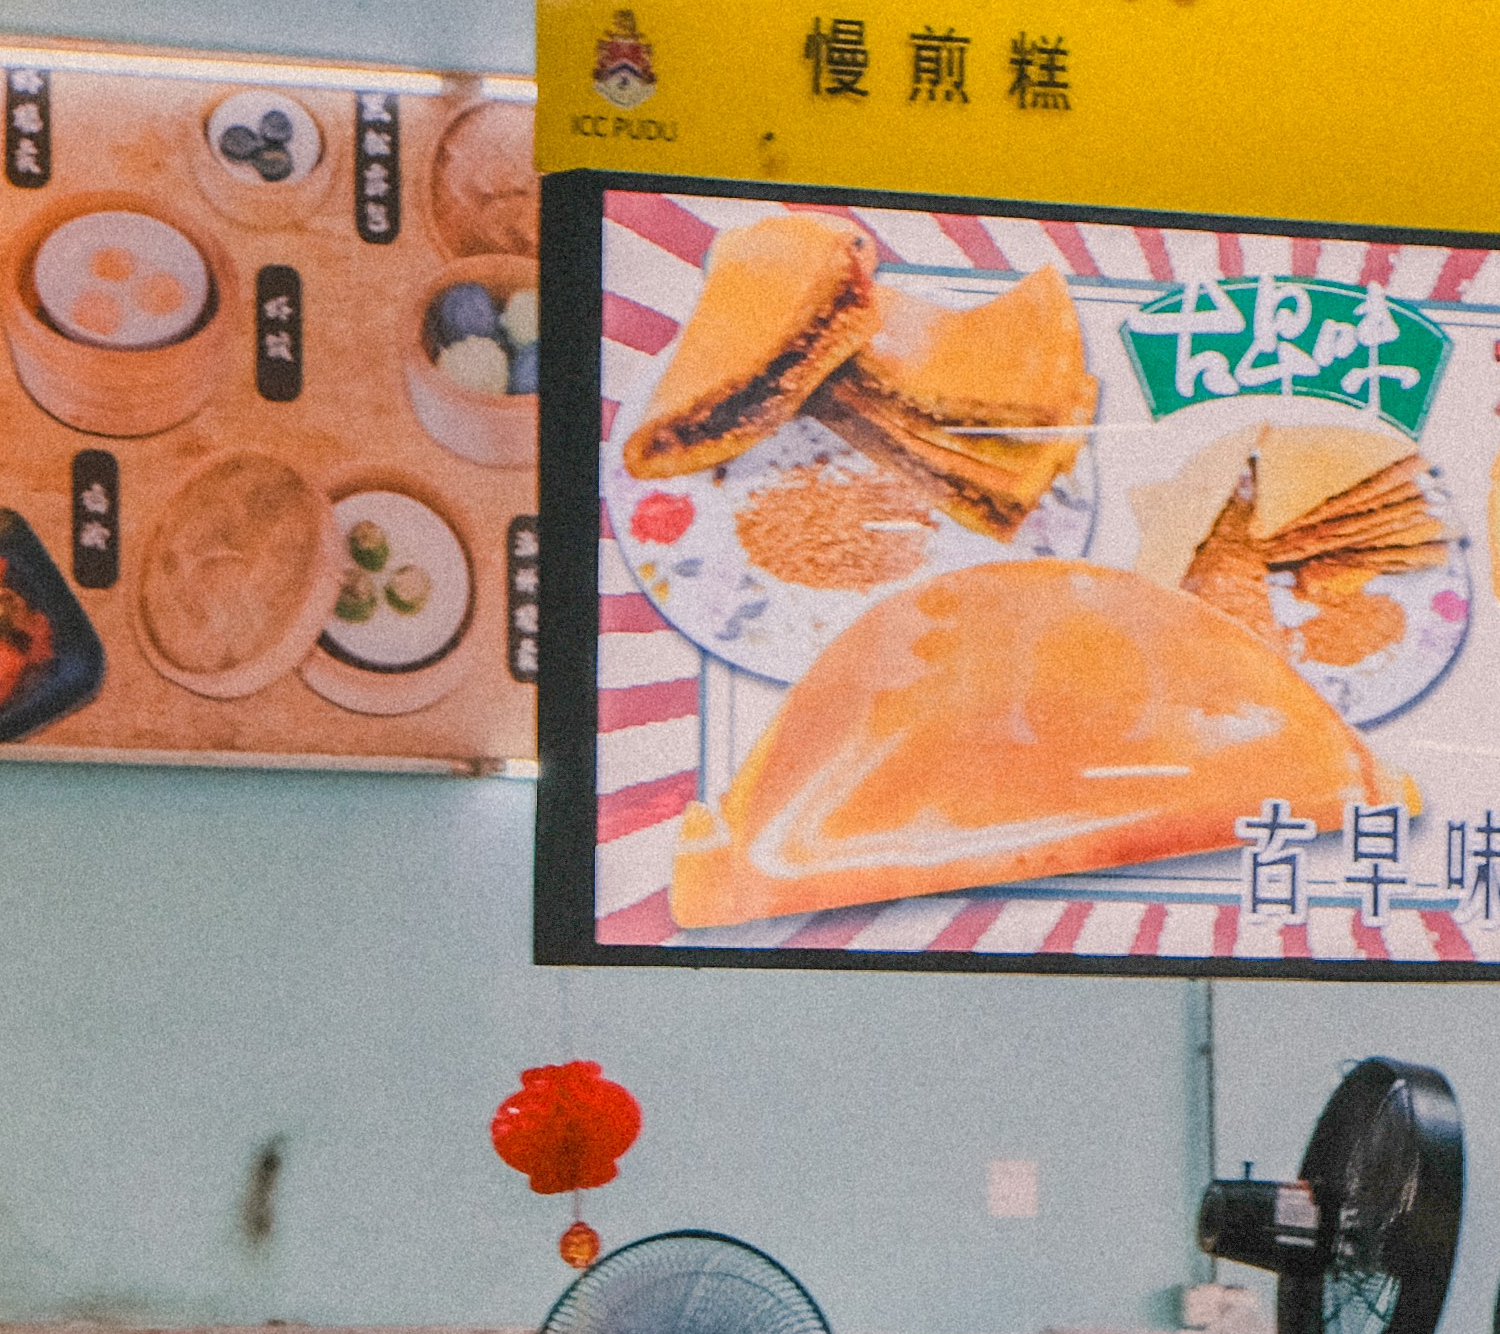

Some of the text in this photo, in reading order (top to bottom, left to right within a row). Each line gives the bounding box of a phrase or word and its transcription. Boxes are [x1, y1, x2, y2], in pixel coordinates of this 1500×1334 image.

[803, 16, 1074, 111] 慢煎糕
[570, 115, 679, 144] ICC PUDU
[1126, 274, 1422, 420] 古早味
